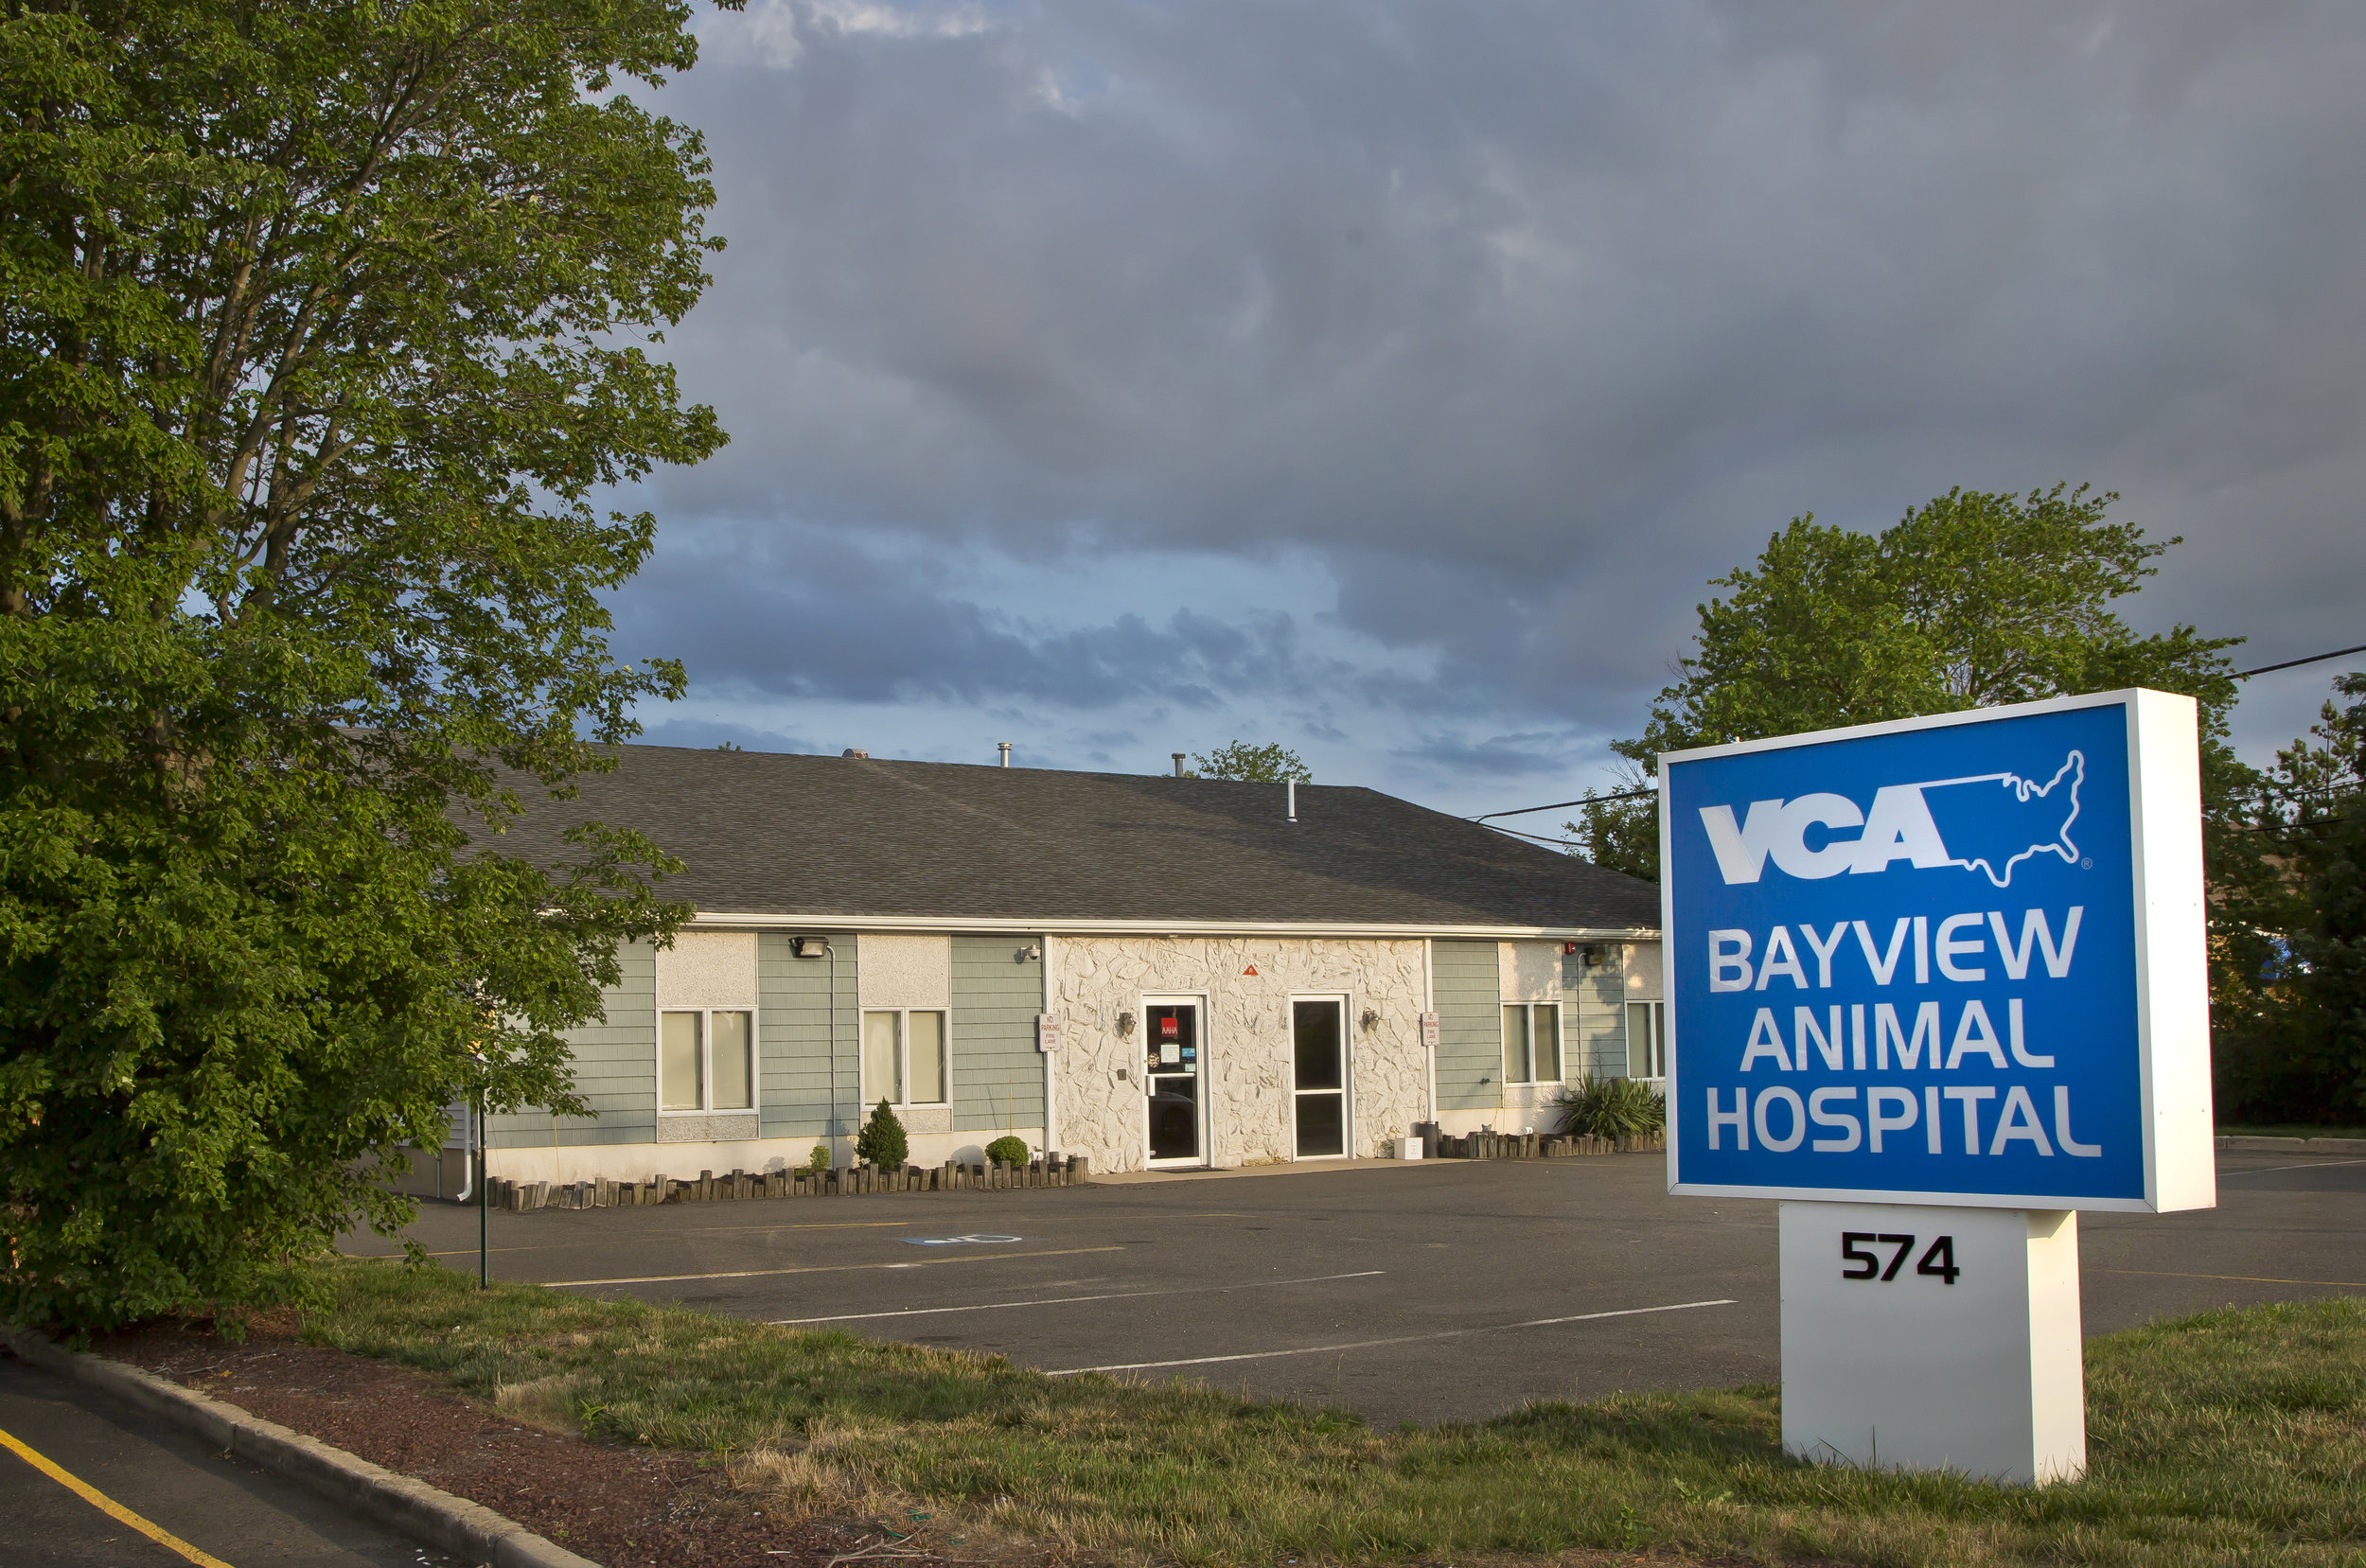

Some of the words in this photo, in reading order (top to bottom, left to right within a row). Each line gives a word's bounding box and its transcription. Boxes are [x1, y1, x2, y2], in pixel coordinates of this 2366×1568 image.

[1699, 784, 1951, 885] VCA
[1708, 906, 2084, 993] BAYVIEW
[1739, 998, 2055, 1072] ANIMAL
[1706, 1085, 2102, 1157] HOSPITAL
[1842, 1231, 1960, 1285] 574
